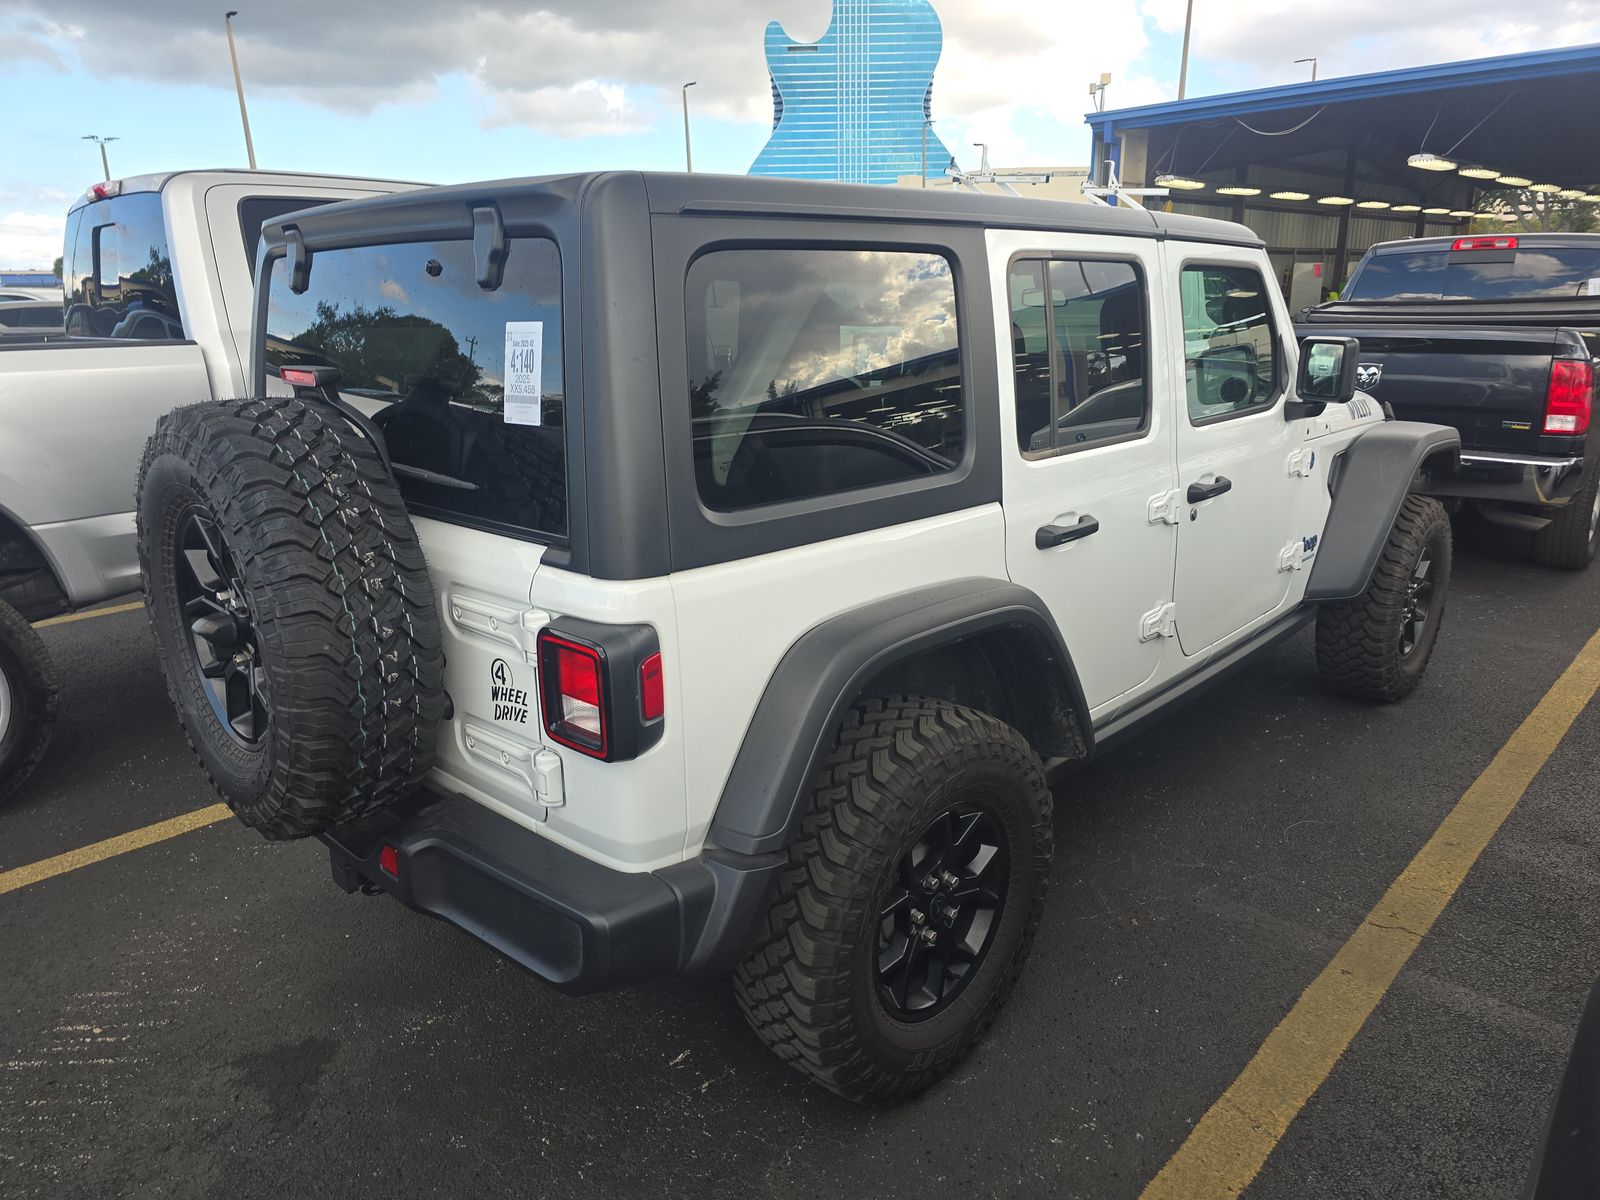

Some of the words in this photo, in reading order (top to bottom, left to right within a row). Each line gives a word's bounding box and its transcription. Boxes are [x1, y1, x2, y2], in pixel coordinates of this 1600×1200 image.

[510, 349, 535, 373] 4:140
[514, 374, 531, 384] 2025
[494, 663, 507, 686] 4
[491, 685, 528, 707] WHEEL
[494, 703, 528, 724] DRIVE
